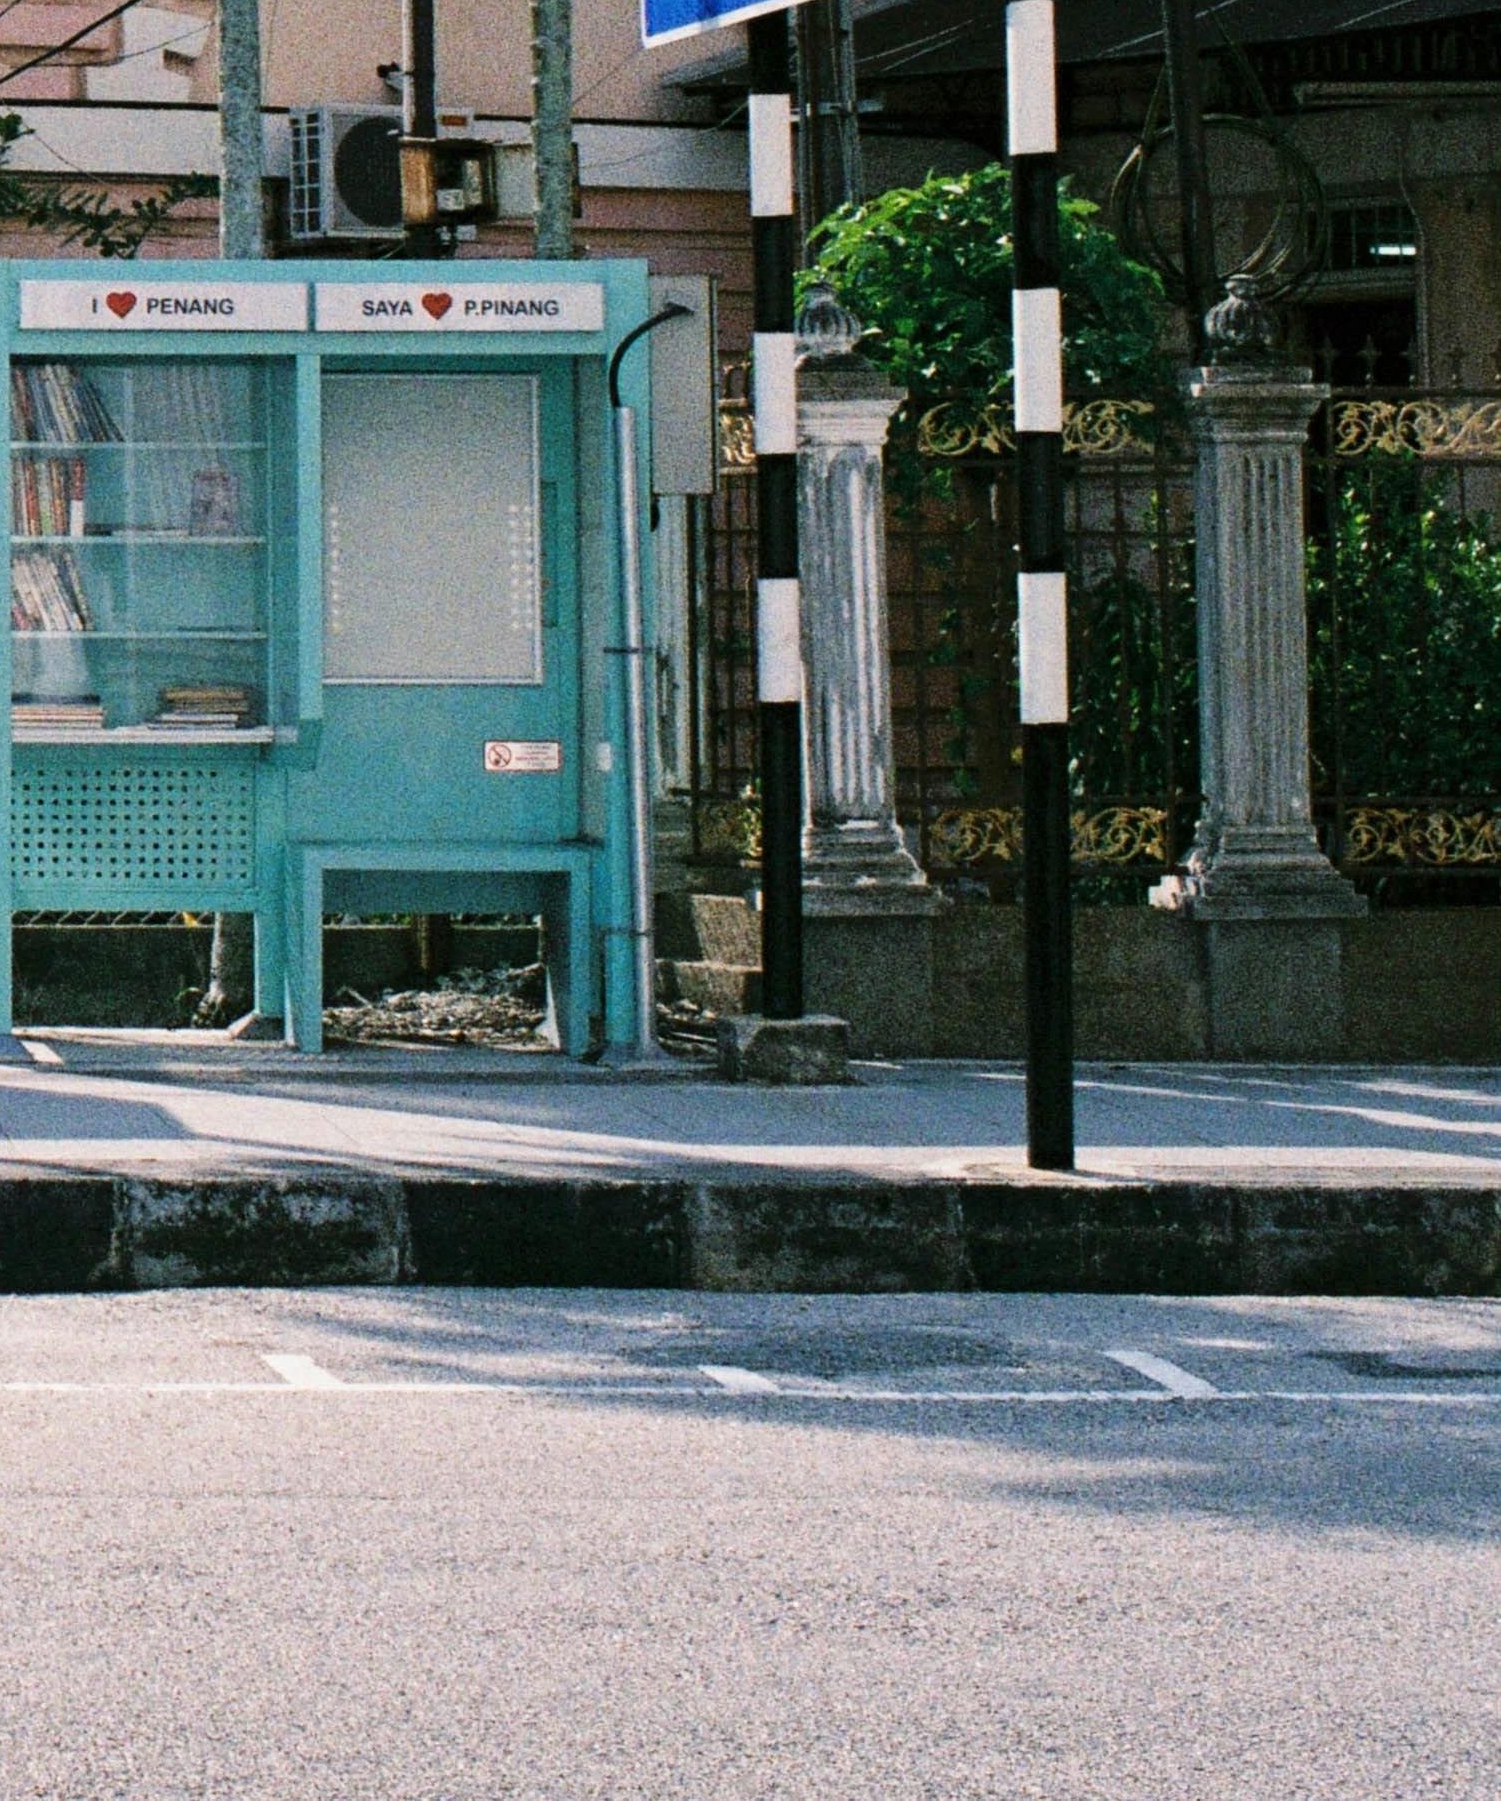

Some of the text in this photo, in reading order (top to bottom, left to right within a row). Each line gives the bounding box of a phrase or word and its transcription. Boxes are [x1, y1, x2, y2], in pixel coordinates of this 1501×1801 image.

[91, 298, 235, 315] I PENANG
[361, 300, 560, 317] SAYA P.PINANG
